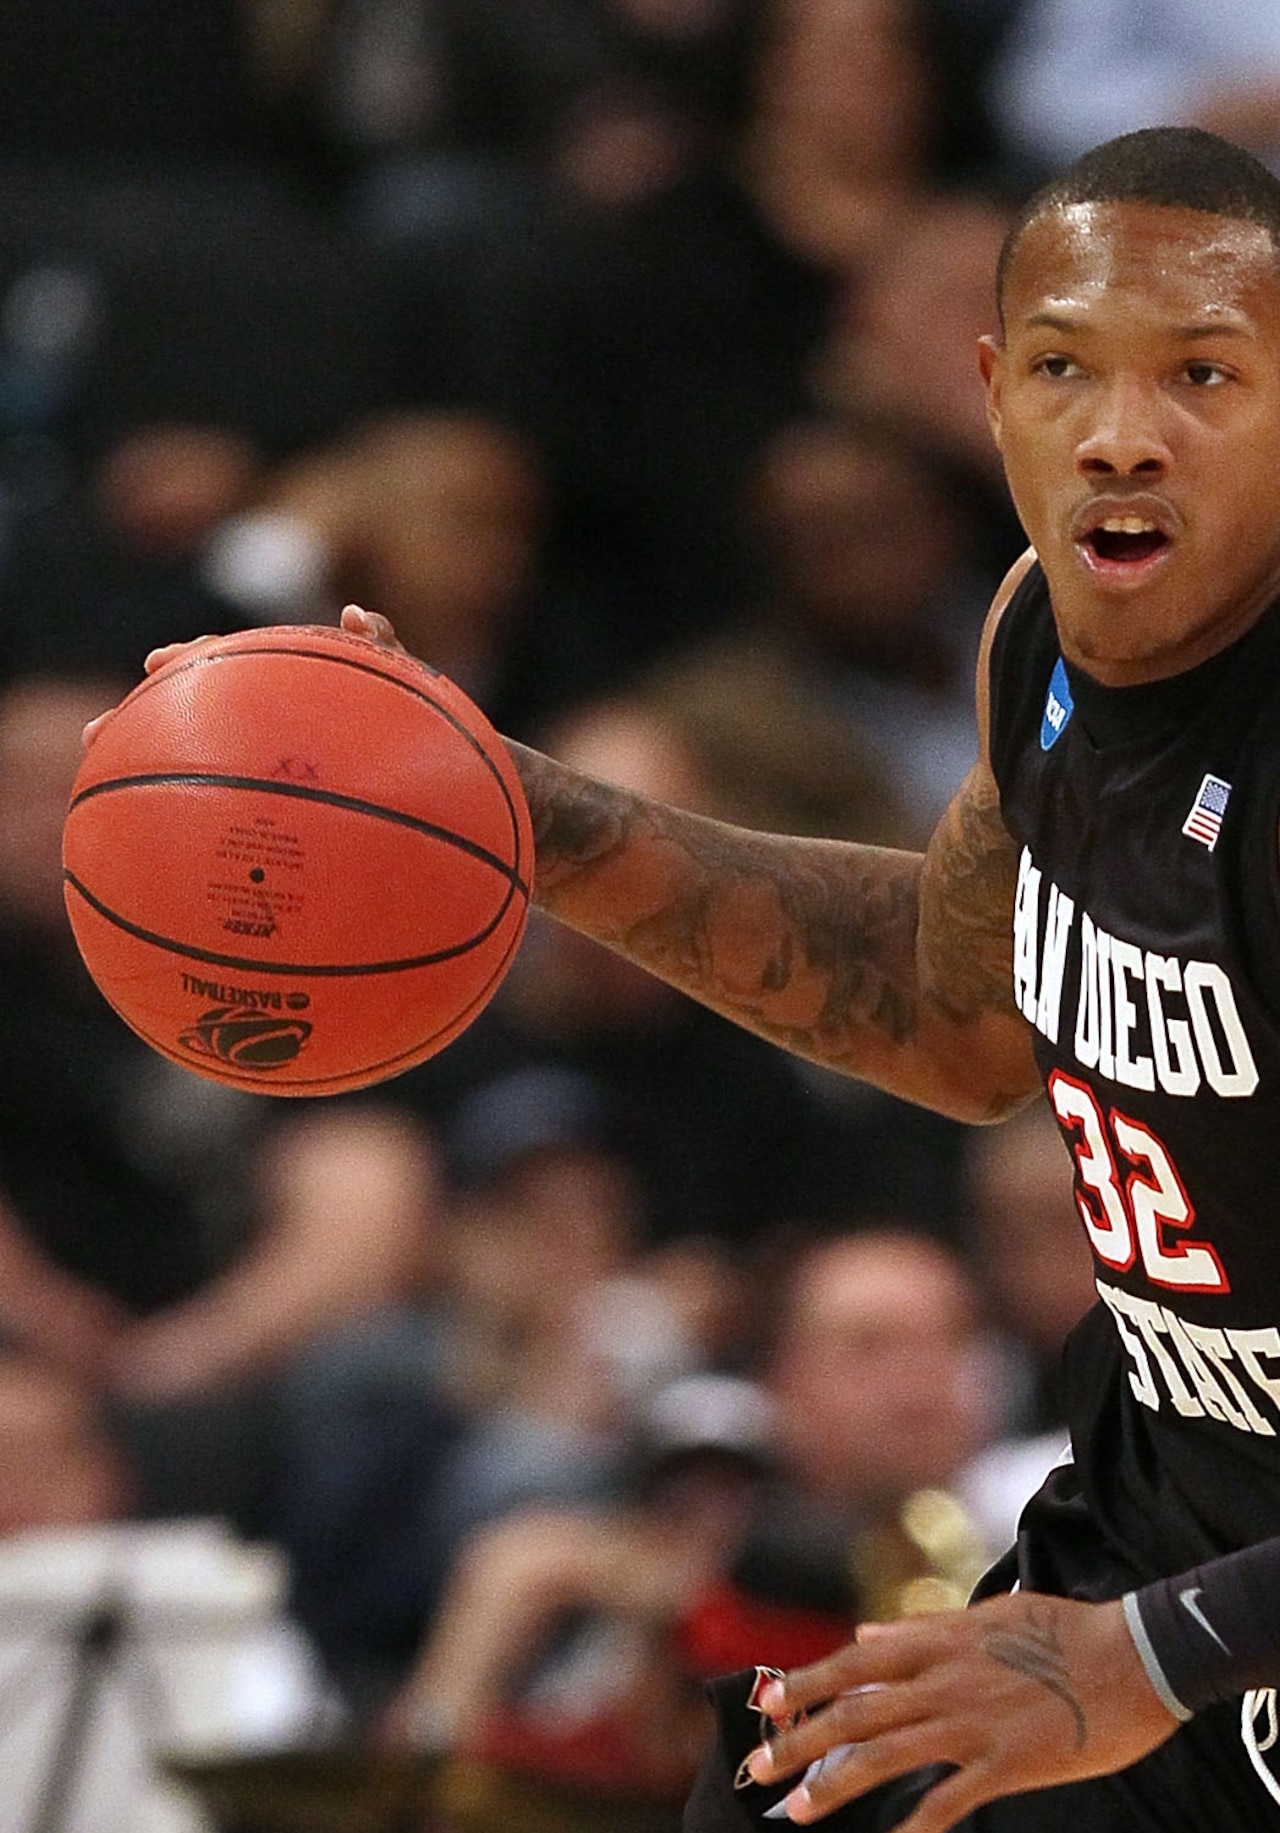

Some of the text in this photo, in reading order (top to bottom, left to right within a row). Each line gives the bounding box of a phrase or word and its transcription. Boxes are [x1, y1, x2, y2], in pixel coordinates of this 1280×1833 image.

[181, 973, 282, 1011] BASKETBALL
[1075, 909, 1260, 1098] DIEGO
[1048, 1067, 1231, 1294] 32
